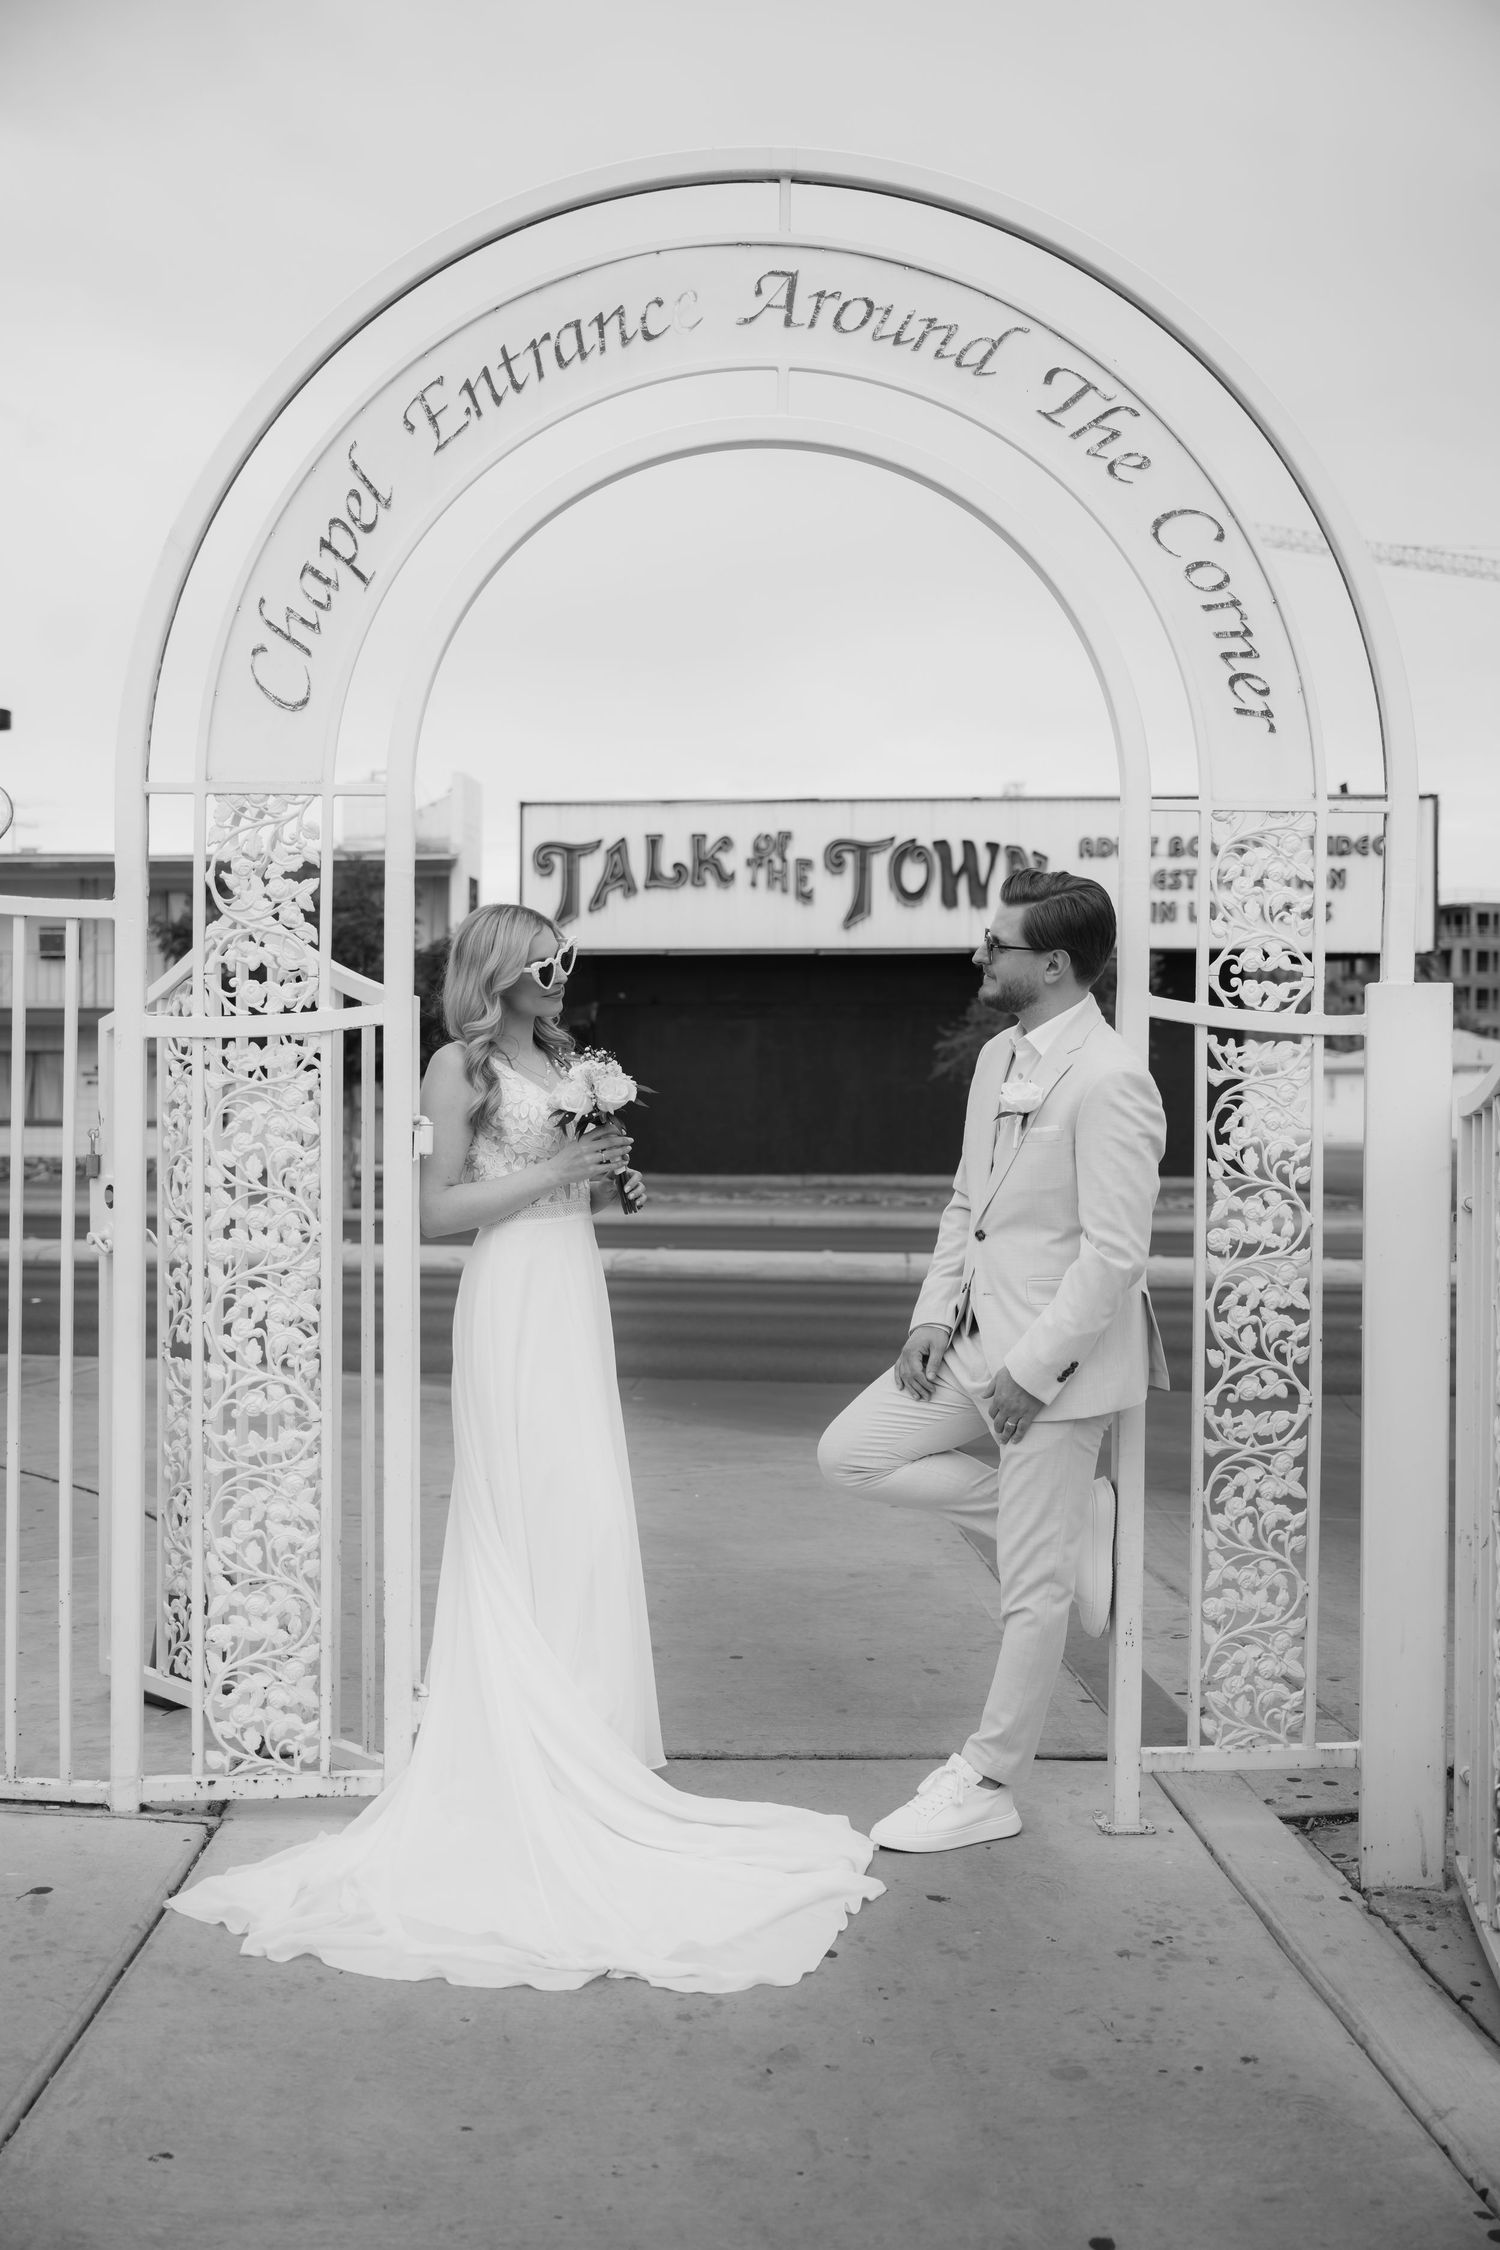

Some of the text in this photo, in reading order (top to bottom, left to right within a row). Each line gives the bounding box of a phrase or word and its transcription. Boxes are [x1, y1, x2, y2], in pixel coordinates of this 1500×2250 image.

[251, 269, 1276, 734] Chapel Entrance Around The Corner
[533, 834, 736, 927] TALK
[746, 858, 814, 904] THE
[753, 831, 793, 863] OF
